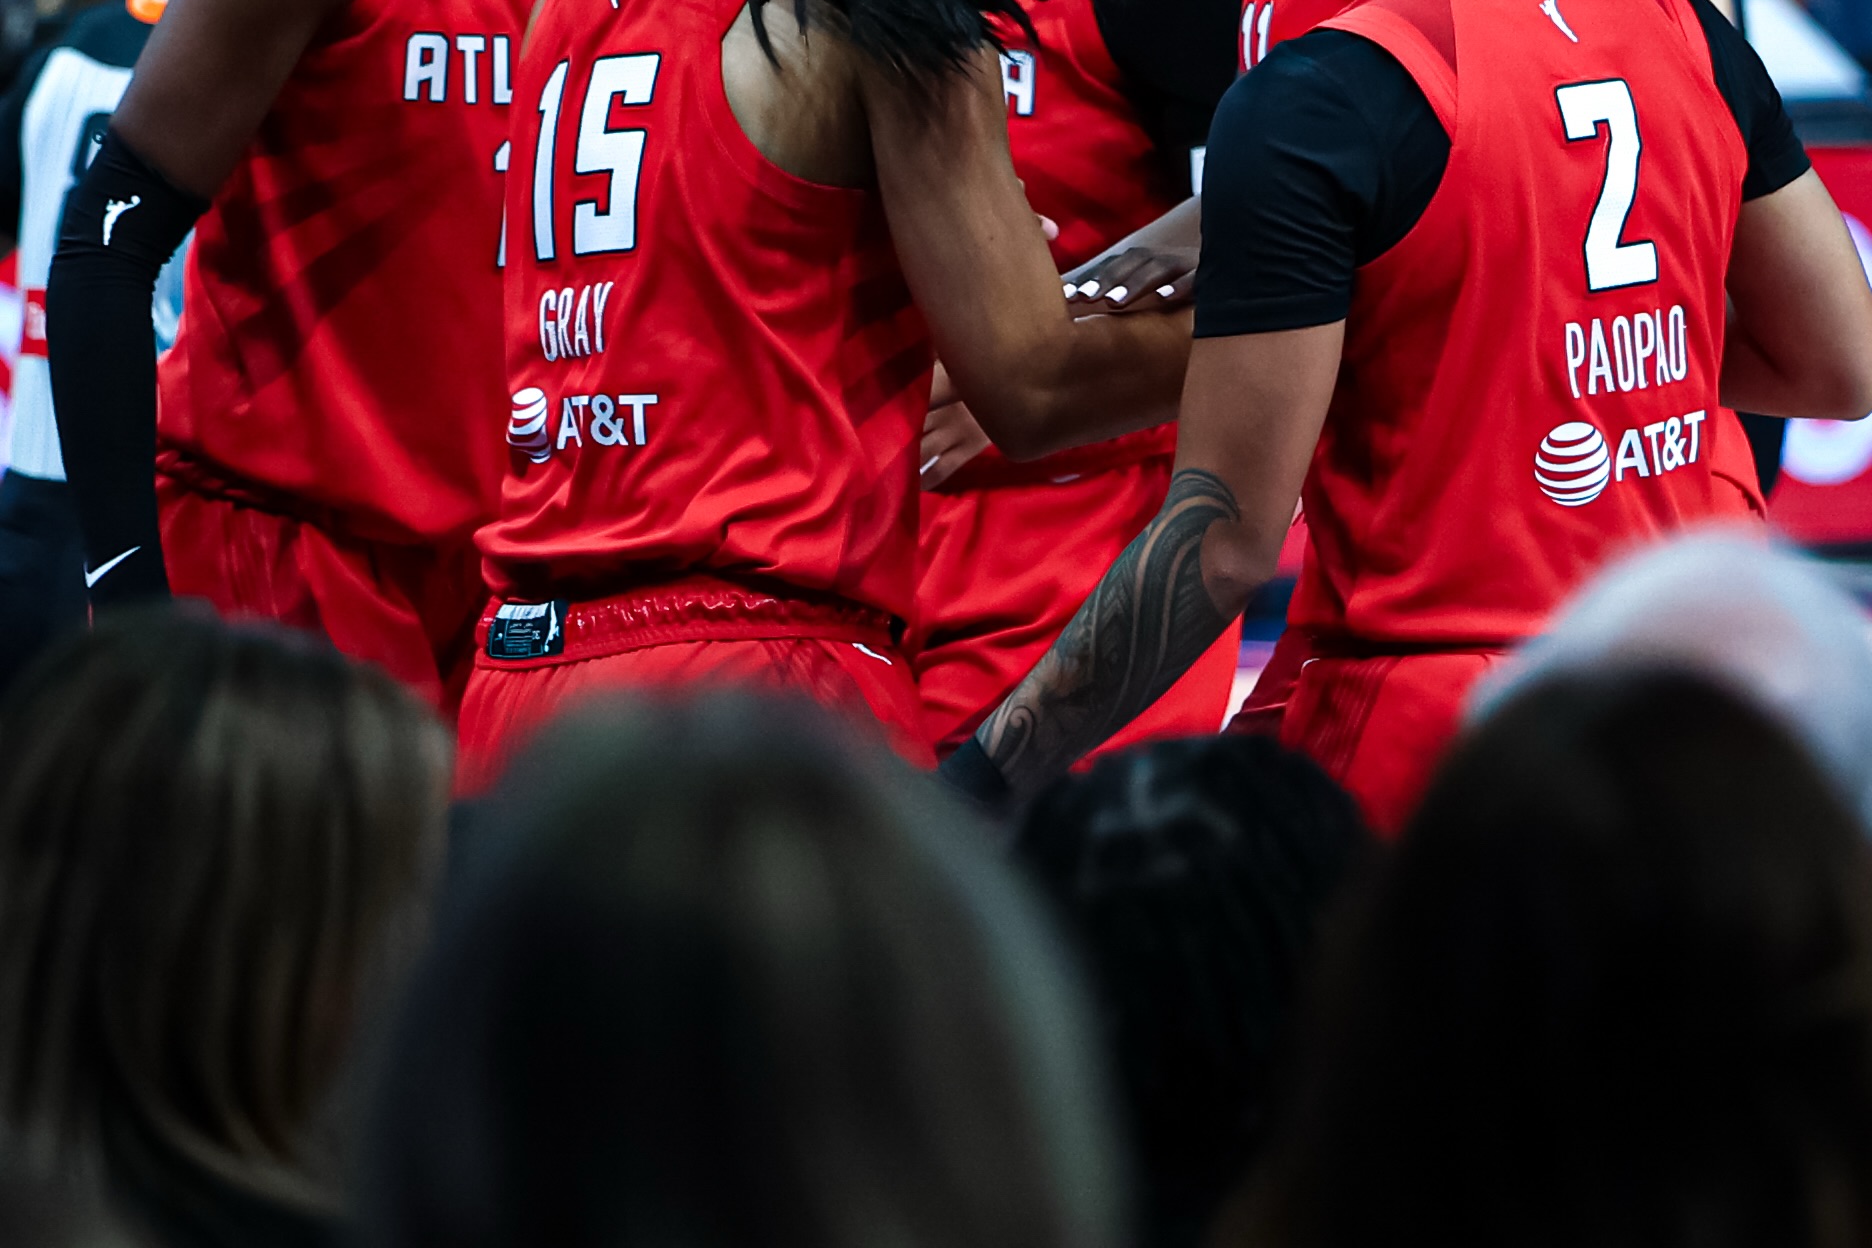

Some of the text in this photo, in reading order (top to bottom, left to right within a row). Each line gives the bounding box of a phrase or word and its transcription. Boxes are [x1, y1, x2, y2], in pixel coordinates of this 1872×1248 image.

[1241, 1, 1273, 71] 11
[533, 52, 661, 262] 15
[1555, 77, 1659, 293] 2
[539, 280, 614, 362] GRAY
[1565, 304, 1687, 399] PAOPAO
[556, 394, 659, 450] AT&T
[1615, 409, 1706, 482] AT&T
